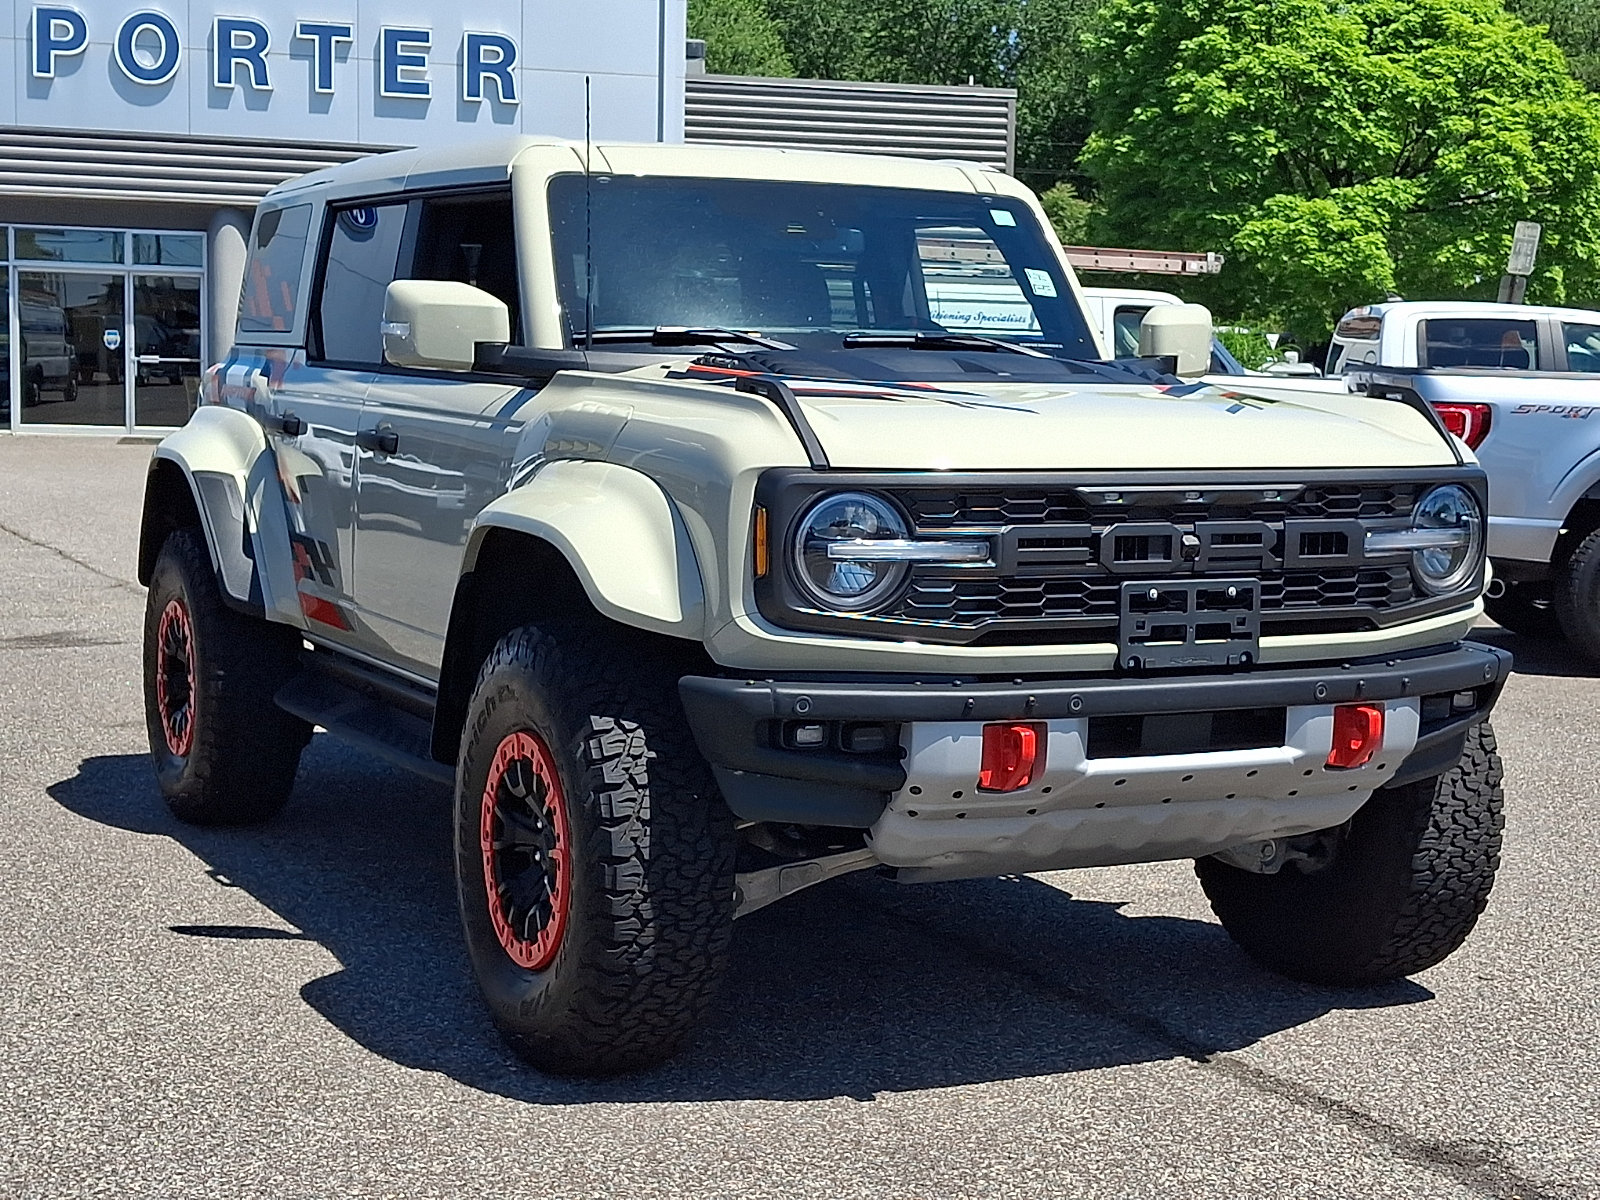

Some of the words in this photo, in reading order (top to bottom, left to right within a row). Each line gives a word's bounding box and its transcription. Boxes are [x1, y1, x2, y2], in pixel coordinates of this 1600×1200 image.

[32, 3, 520, 104] PORTER
[973, 311, 1027, 325] Specialists
[1510, 404, 1600, 420] SPORT
[1000, 519, 1364, 577] FORD
